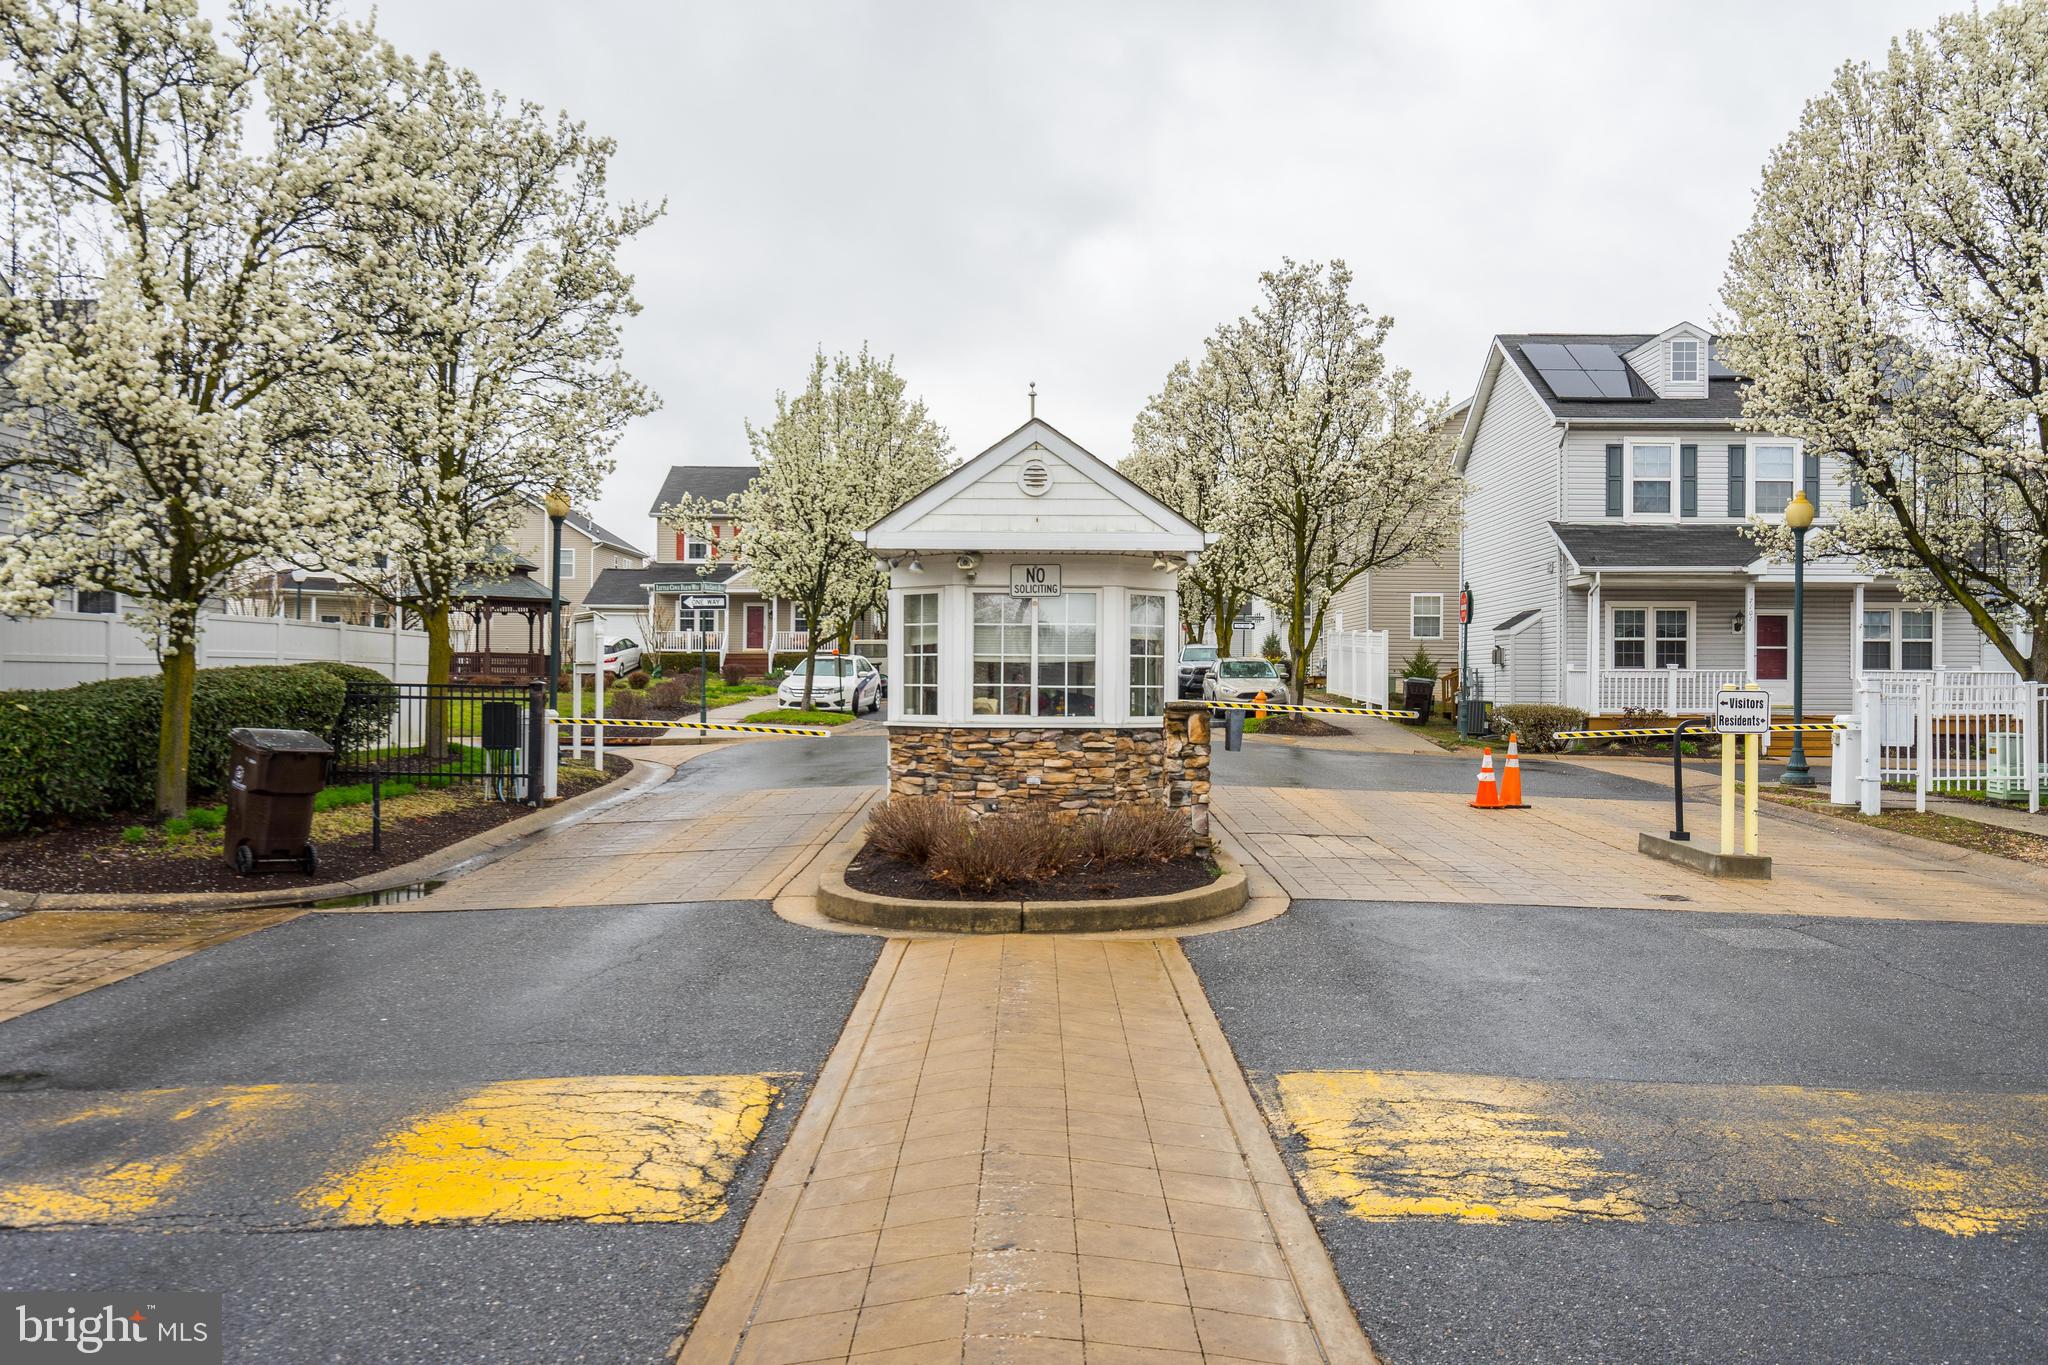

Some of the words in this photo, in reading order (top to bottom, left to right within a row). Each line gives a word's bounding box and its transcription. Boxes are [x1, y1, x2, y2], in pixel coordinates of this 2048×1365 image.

[1026, 567, 1045, 583] NO
[1014, 584, 1058, 594] SOLICITING
[1729, 697, 1764, 709] Visitors
[1719, 714, 1760, 726] Residents
